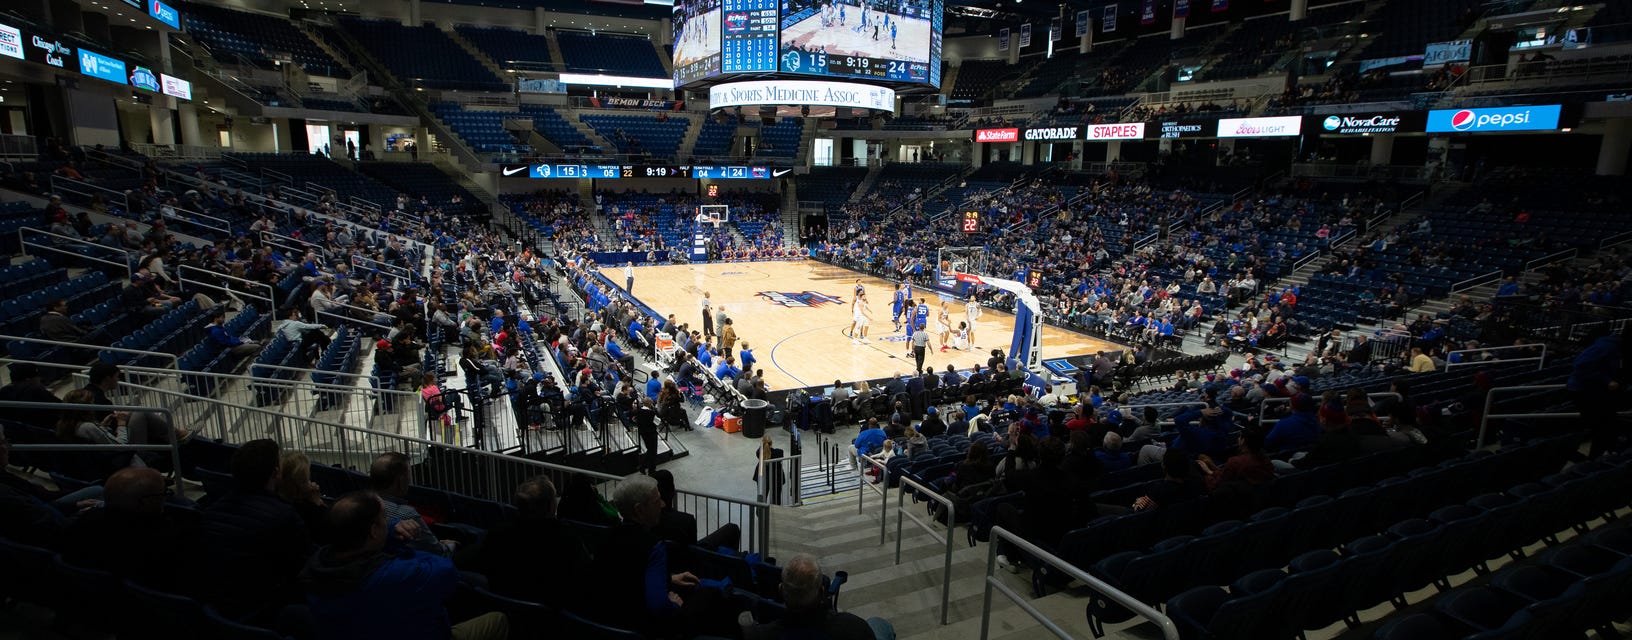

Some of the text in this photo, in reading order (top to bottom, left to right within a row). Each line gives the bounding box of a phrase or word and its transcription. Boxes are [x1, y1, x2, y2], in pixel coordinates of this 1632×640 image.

[809, 54, 826, 67] 15
[846, 56, 869, 68] 9:19
[889, 61, 906, 74] 24
[607, 98, 639, 106] DEMON
[723, 92, 728, 103] &
[1340, 115, 1400, 128] NovaCare
[1477, 111, 1531, 128] pepsi
[1025, 127, 1077, 139] GATORADE
[1093, 126, 1138, 138] STAPLES
[1262, 125, 1285, 133] LIGHT
[563, 167, 574, 176] 15
[582, 169, 587, 177] 3
[647, 168, 666, 176] 9:19
[733, 169, 742, 177] 24
[964, 219, 977, 231] 22
[1031, 278, 1039, 287] 22
